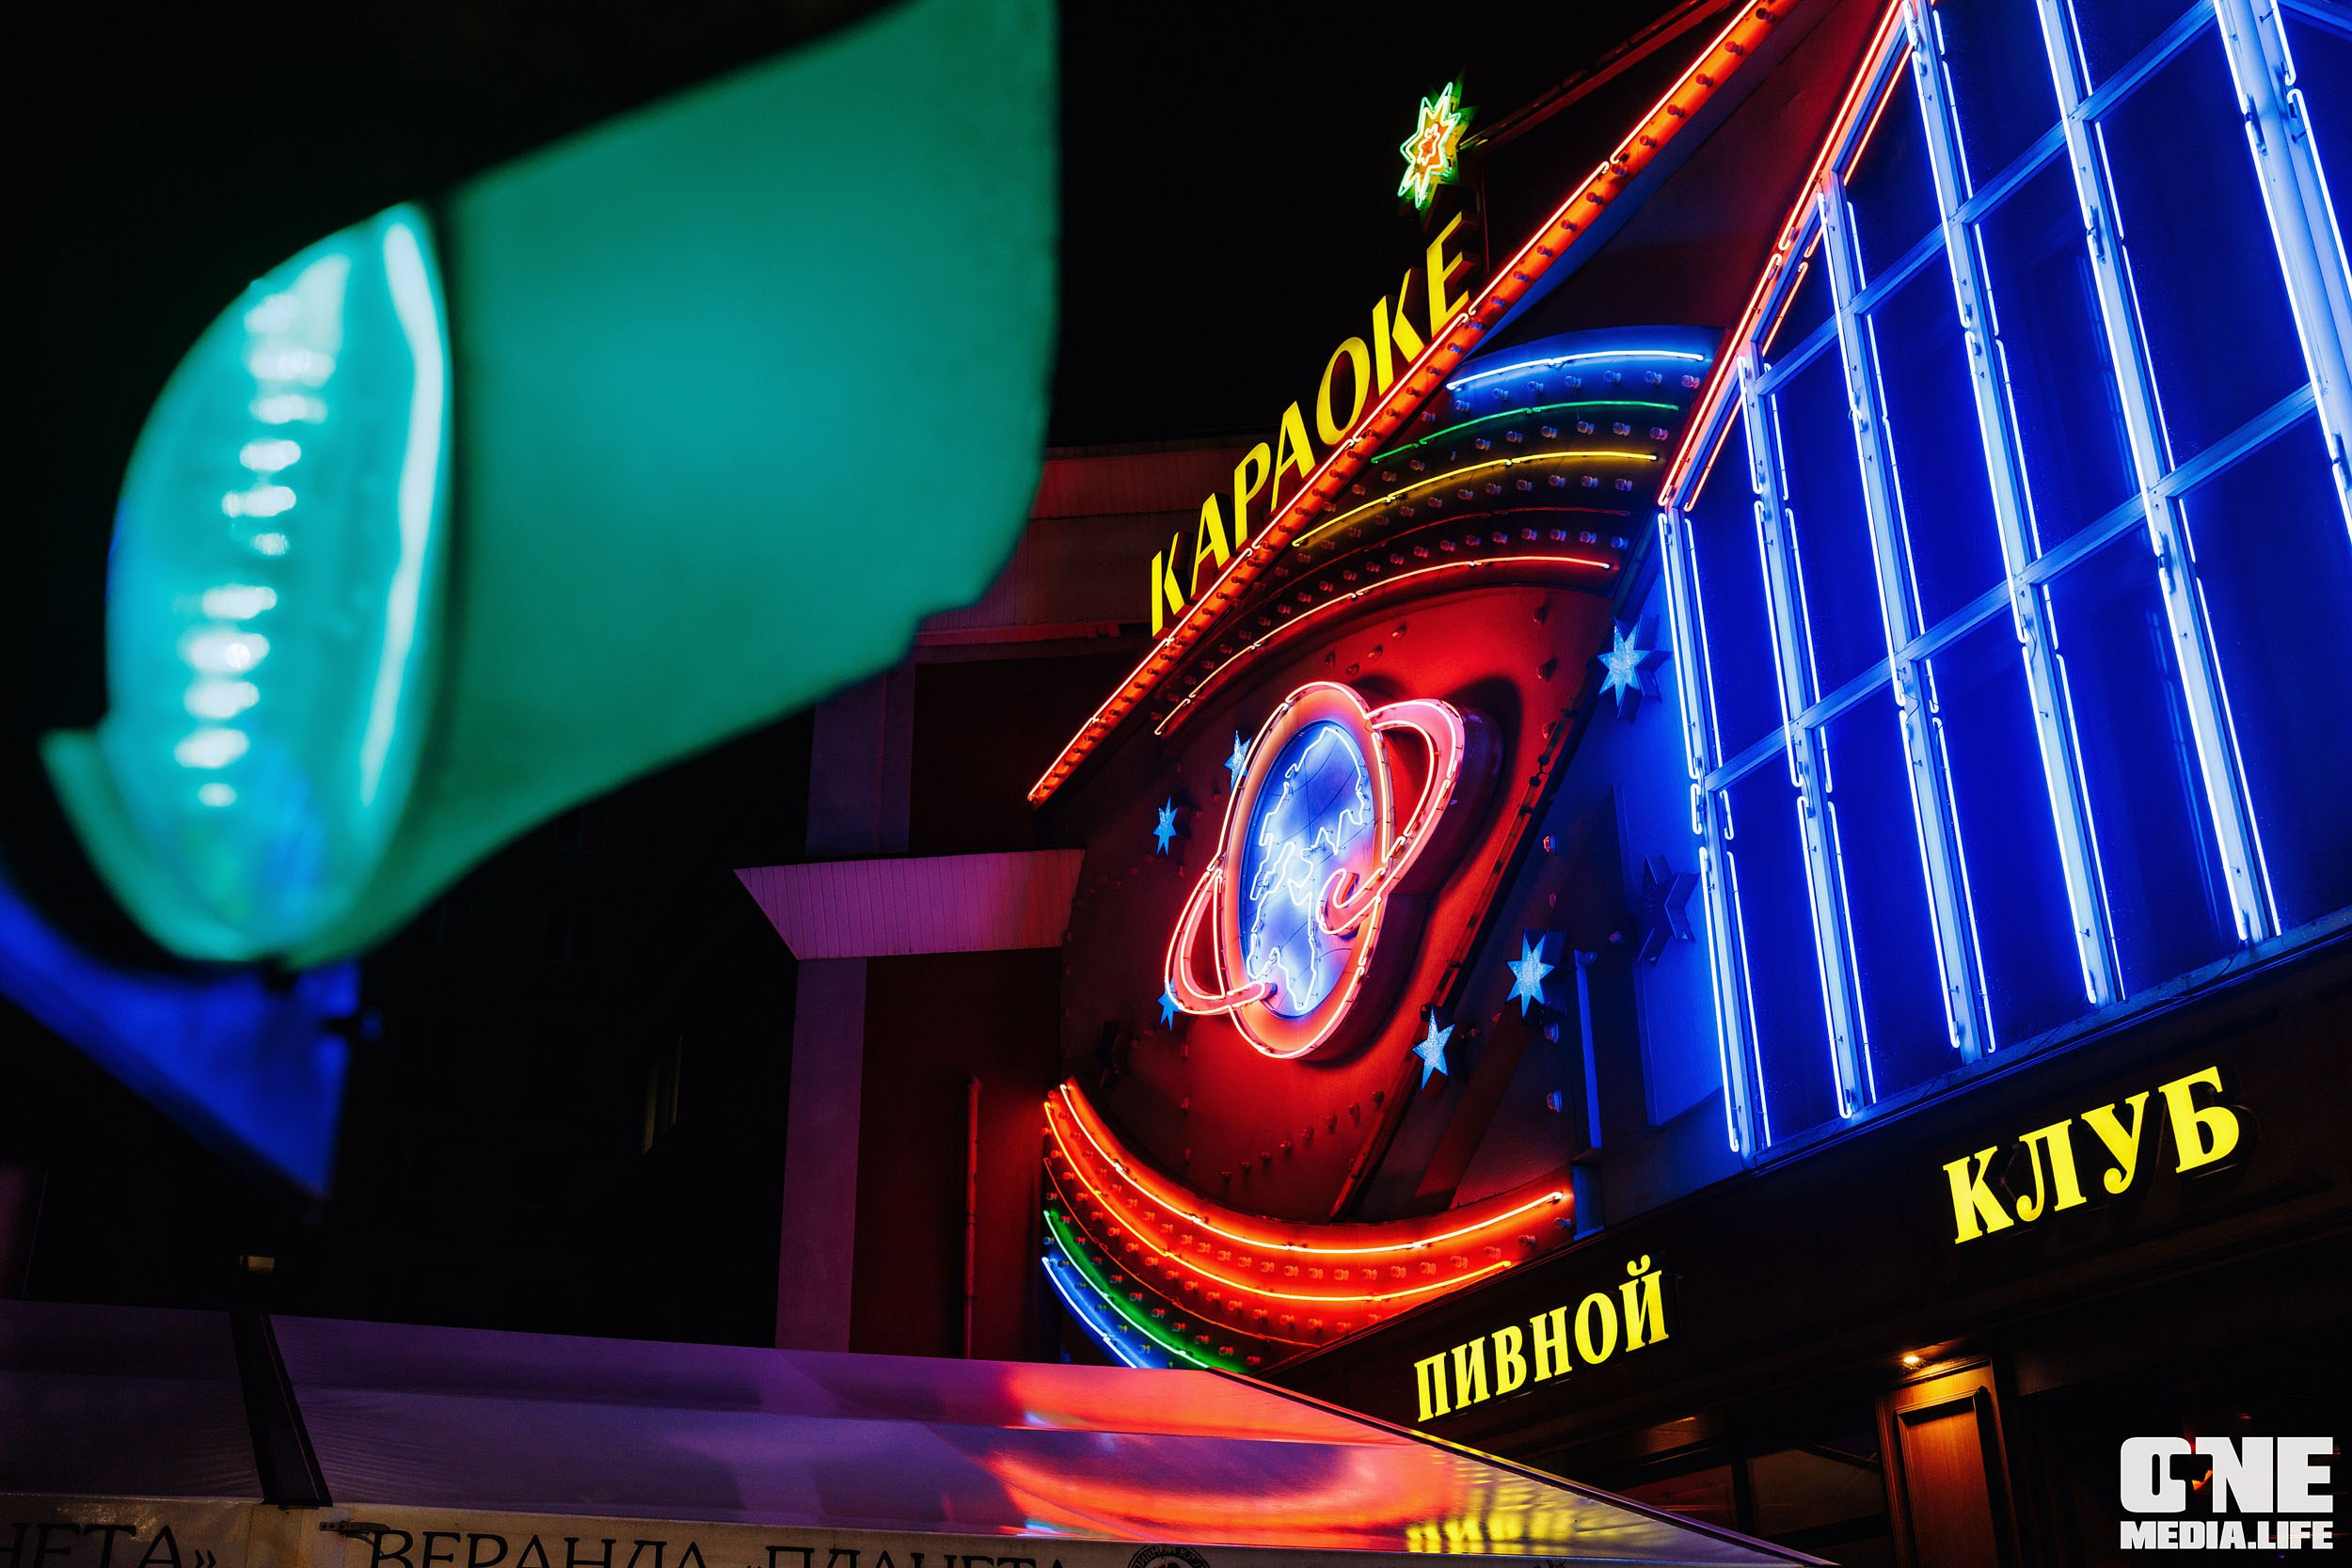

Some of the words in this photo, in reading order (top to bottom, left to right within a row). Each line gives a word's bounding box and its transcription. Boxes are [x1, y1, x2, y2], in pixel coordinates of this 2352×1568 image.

[1151, 211, 1470, 638] КАРАОКЕ
[1413, 1254, 1670, 1423] ПИВНОЙ
[1942, 1065, 2241, 1245] КЛУБ
